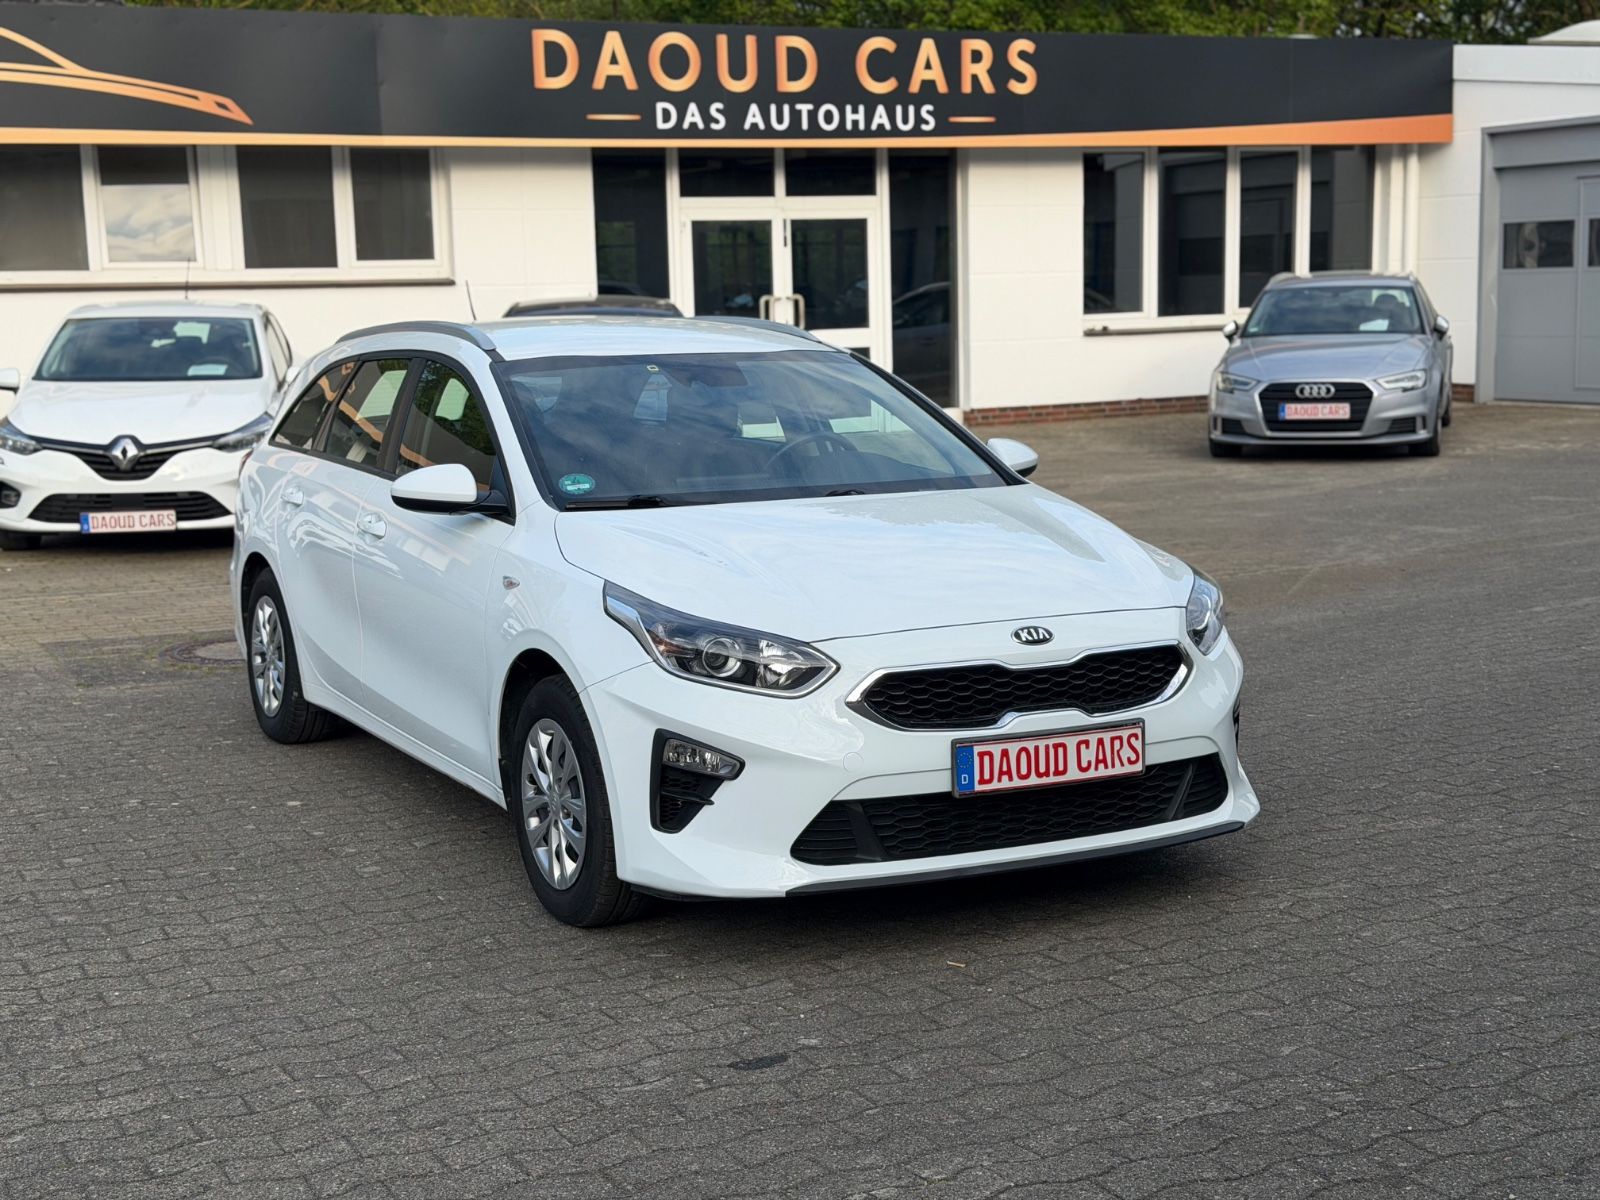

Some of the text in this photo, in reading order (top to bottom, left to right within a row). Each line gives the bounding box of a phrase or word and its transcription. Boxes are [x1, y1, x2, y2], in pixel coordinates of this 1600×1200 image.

[531, 29, 1038, 95] DAOUD CARS
[655, 101, 936, 132] DAS AUTOHAUS
[1287, 404, 1348, 417] DAOUD CARS
[91, 515, 135, 529] DAOUD
[139, 513, 175, 528] CARS
[1017, 627, 1050, 642] KIA
[977, 733, 1140, 786] DAOUD CARS
[961, 774, 968, 785] D
